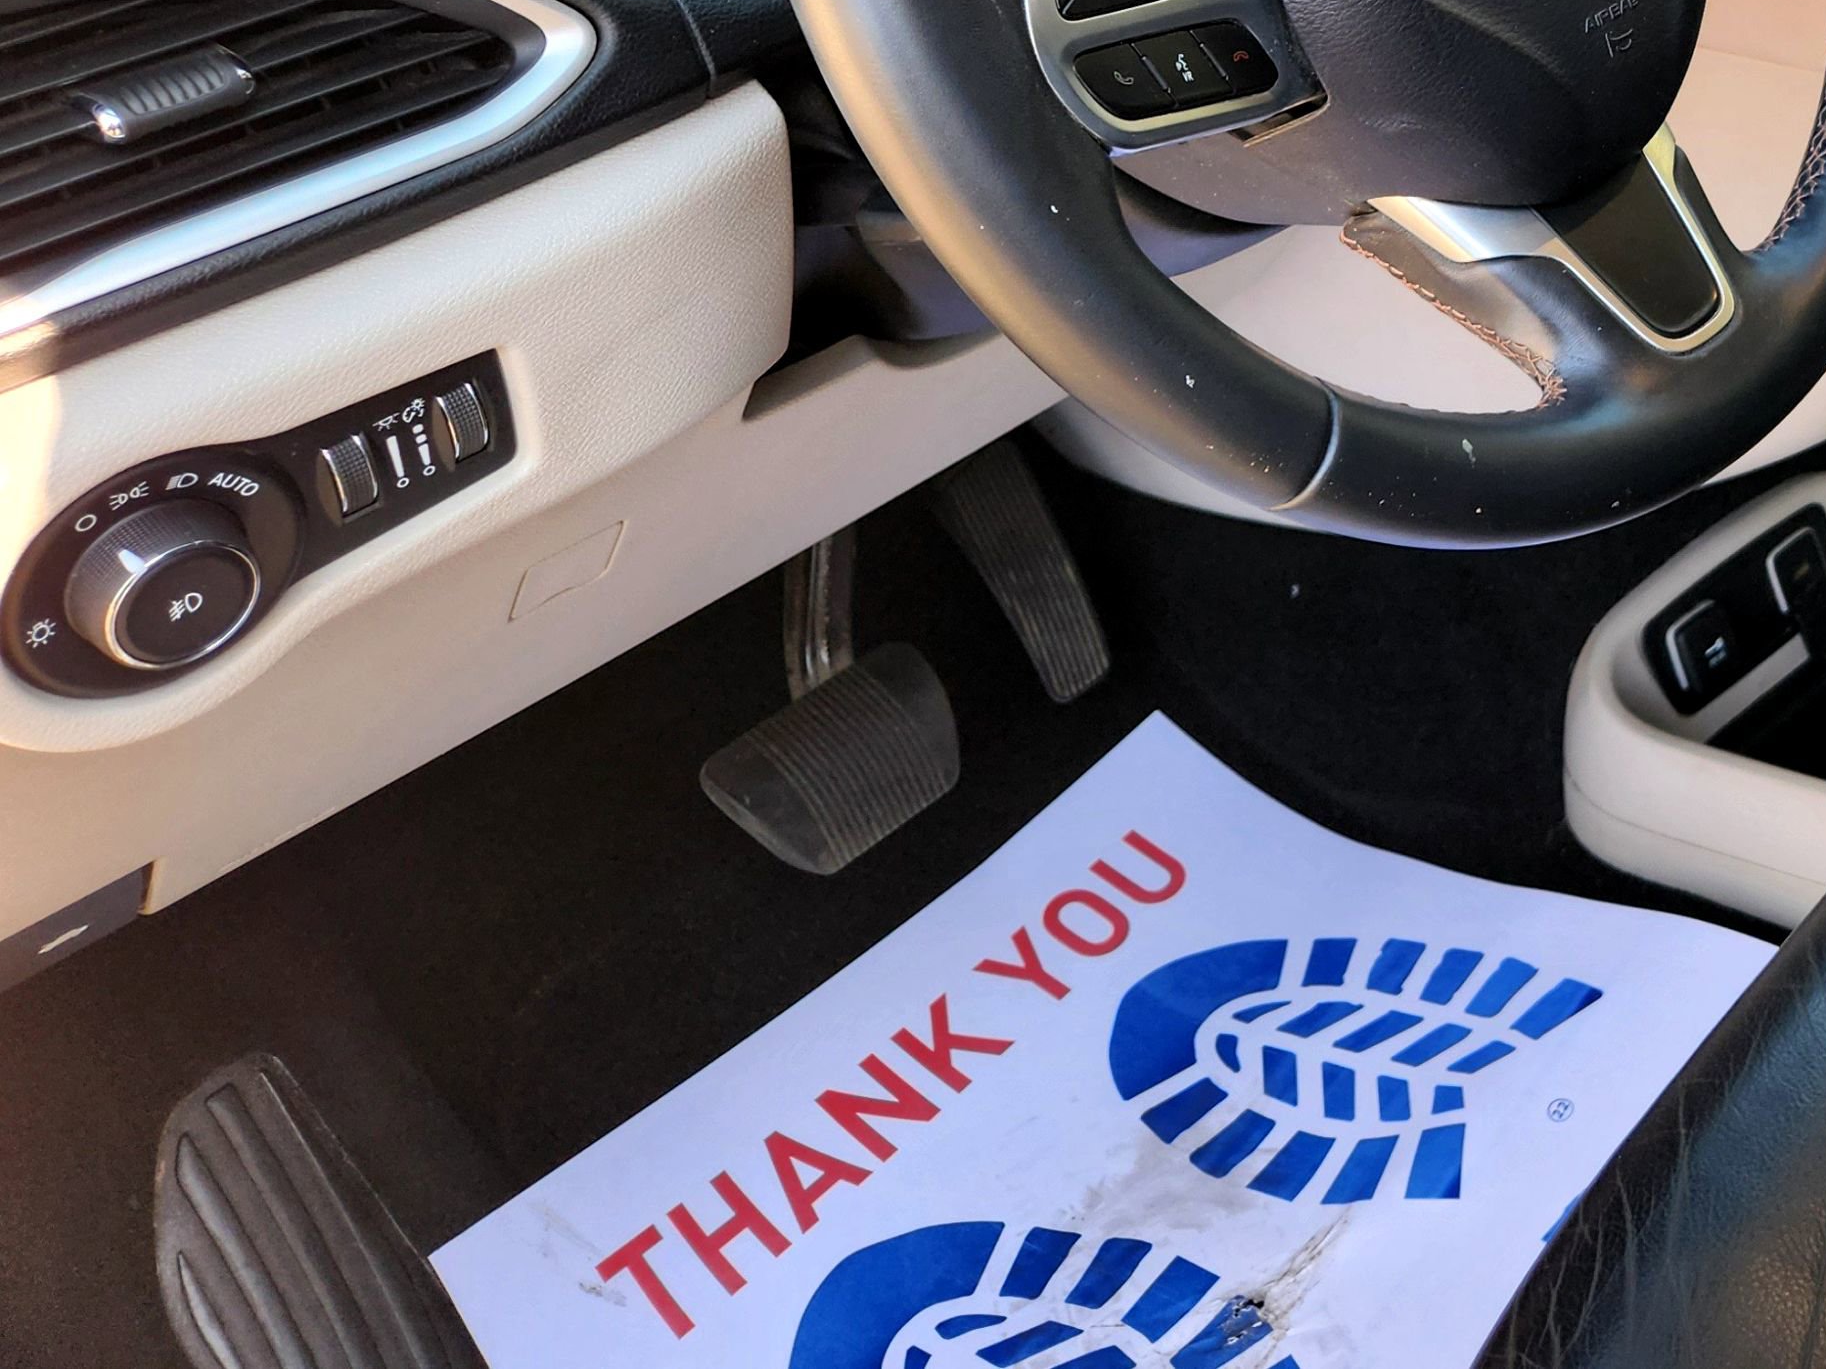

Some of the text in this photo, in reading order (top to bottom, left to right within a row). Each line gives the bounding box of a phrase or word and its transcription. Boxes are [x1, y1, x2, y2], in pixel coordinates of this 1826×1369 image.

[1182, 71, 1195, 83] VR
[207, 471, 260, 497] AUTO
[595, 829, 1188, 1339] THANK YOU
